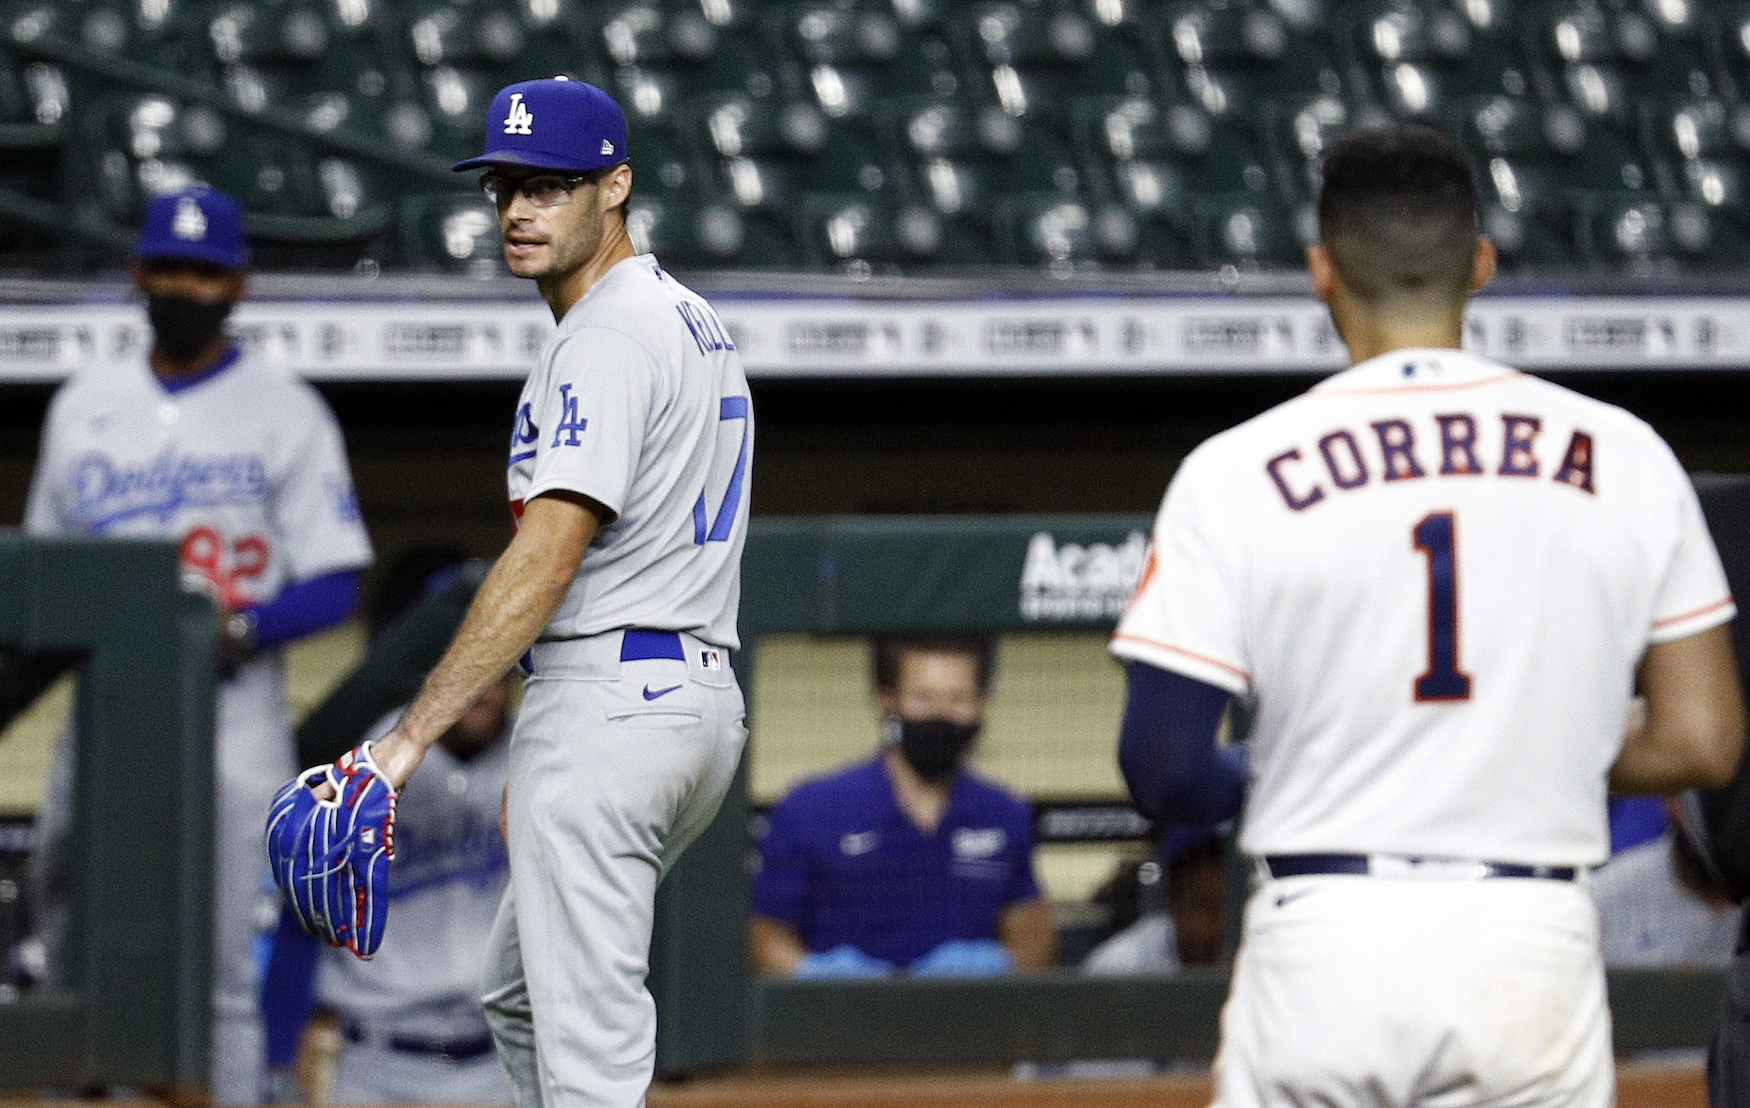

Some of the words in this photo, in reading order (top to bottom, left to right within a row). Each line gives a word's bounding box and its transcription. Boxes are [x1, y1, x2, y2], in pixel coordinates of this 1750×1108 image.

[504, 93, 533, 134] LA
[551, 383, 588, 448] LA
[67, 449, 270, 532] Dodgers
[1266, 413, 1595, 511] CORREA
[178, 525, 272, 612] 92
[1412, 512, 1473, 702] 1
